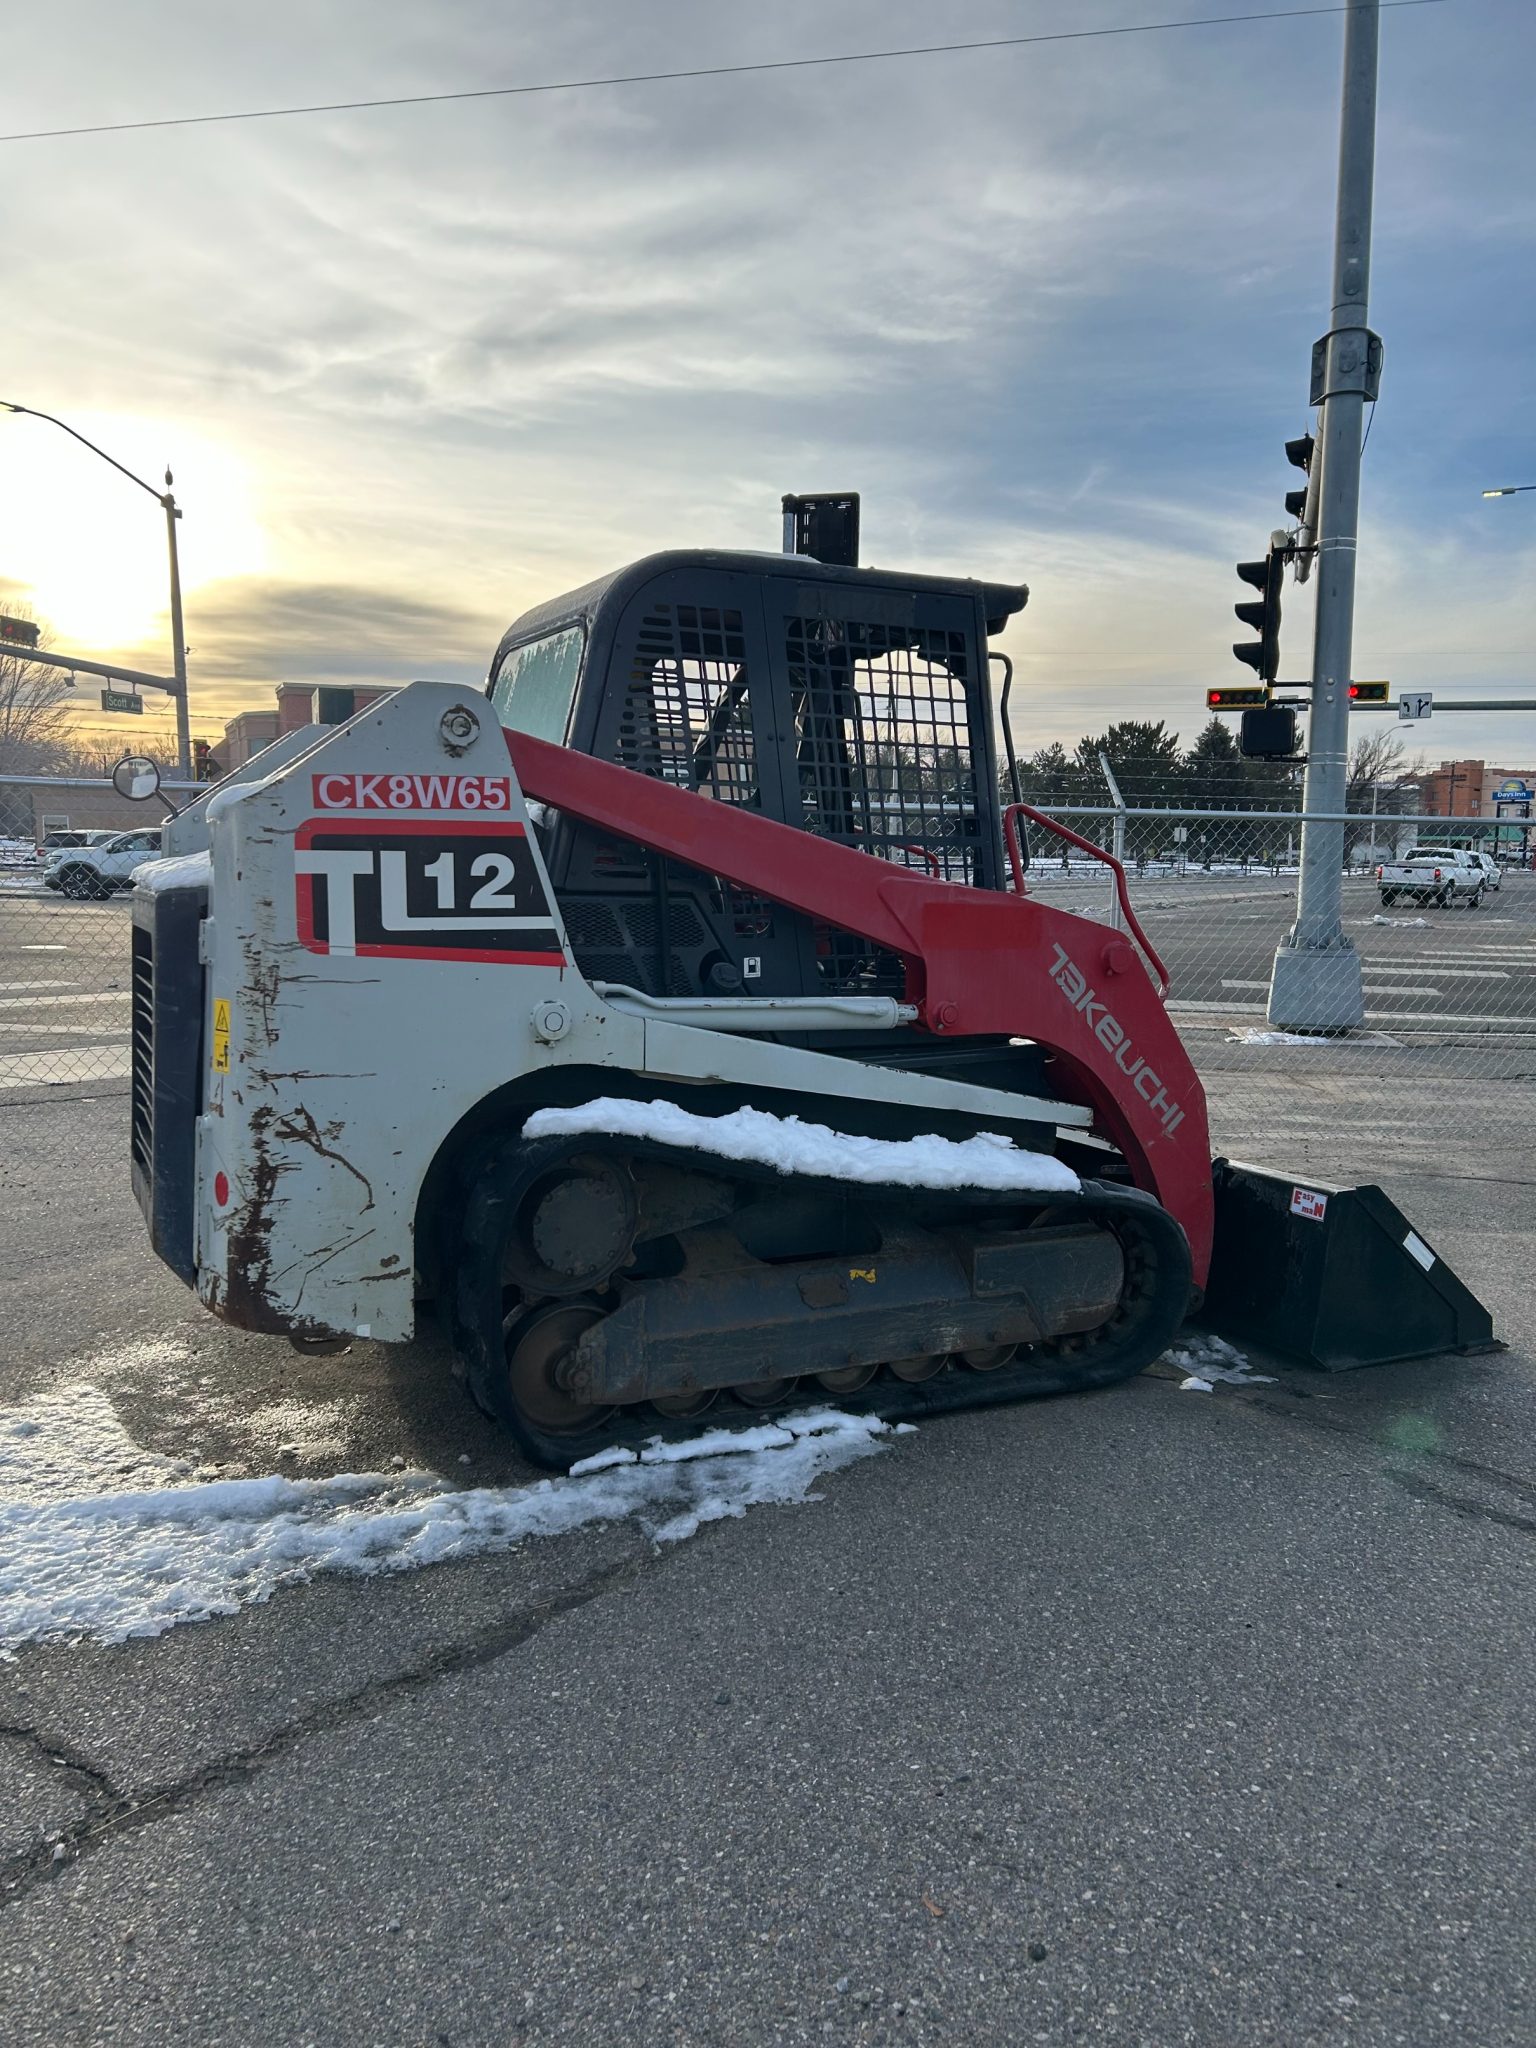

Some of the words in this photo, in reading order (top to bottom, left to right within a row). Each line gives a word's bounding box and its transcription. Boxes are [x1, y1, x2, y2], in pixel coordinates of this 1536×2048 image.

[108, 695, 127, 708] Scott
[318, 775, 506, 809] CK8W65
[1294, 1190, 1315, 1205] Easy
